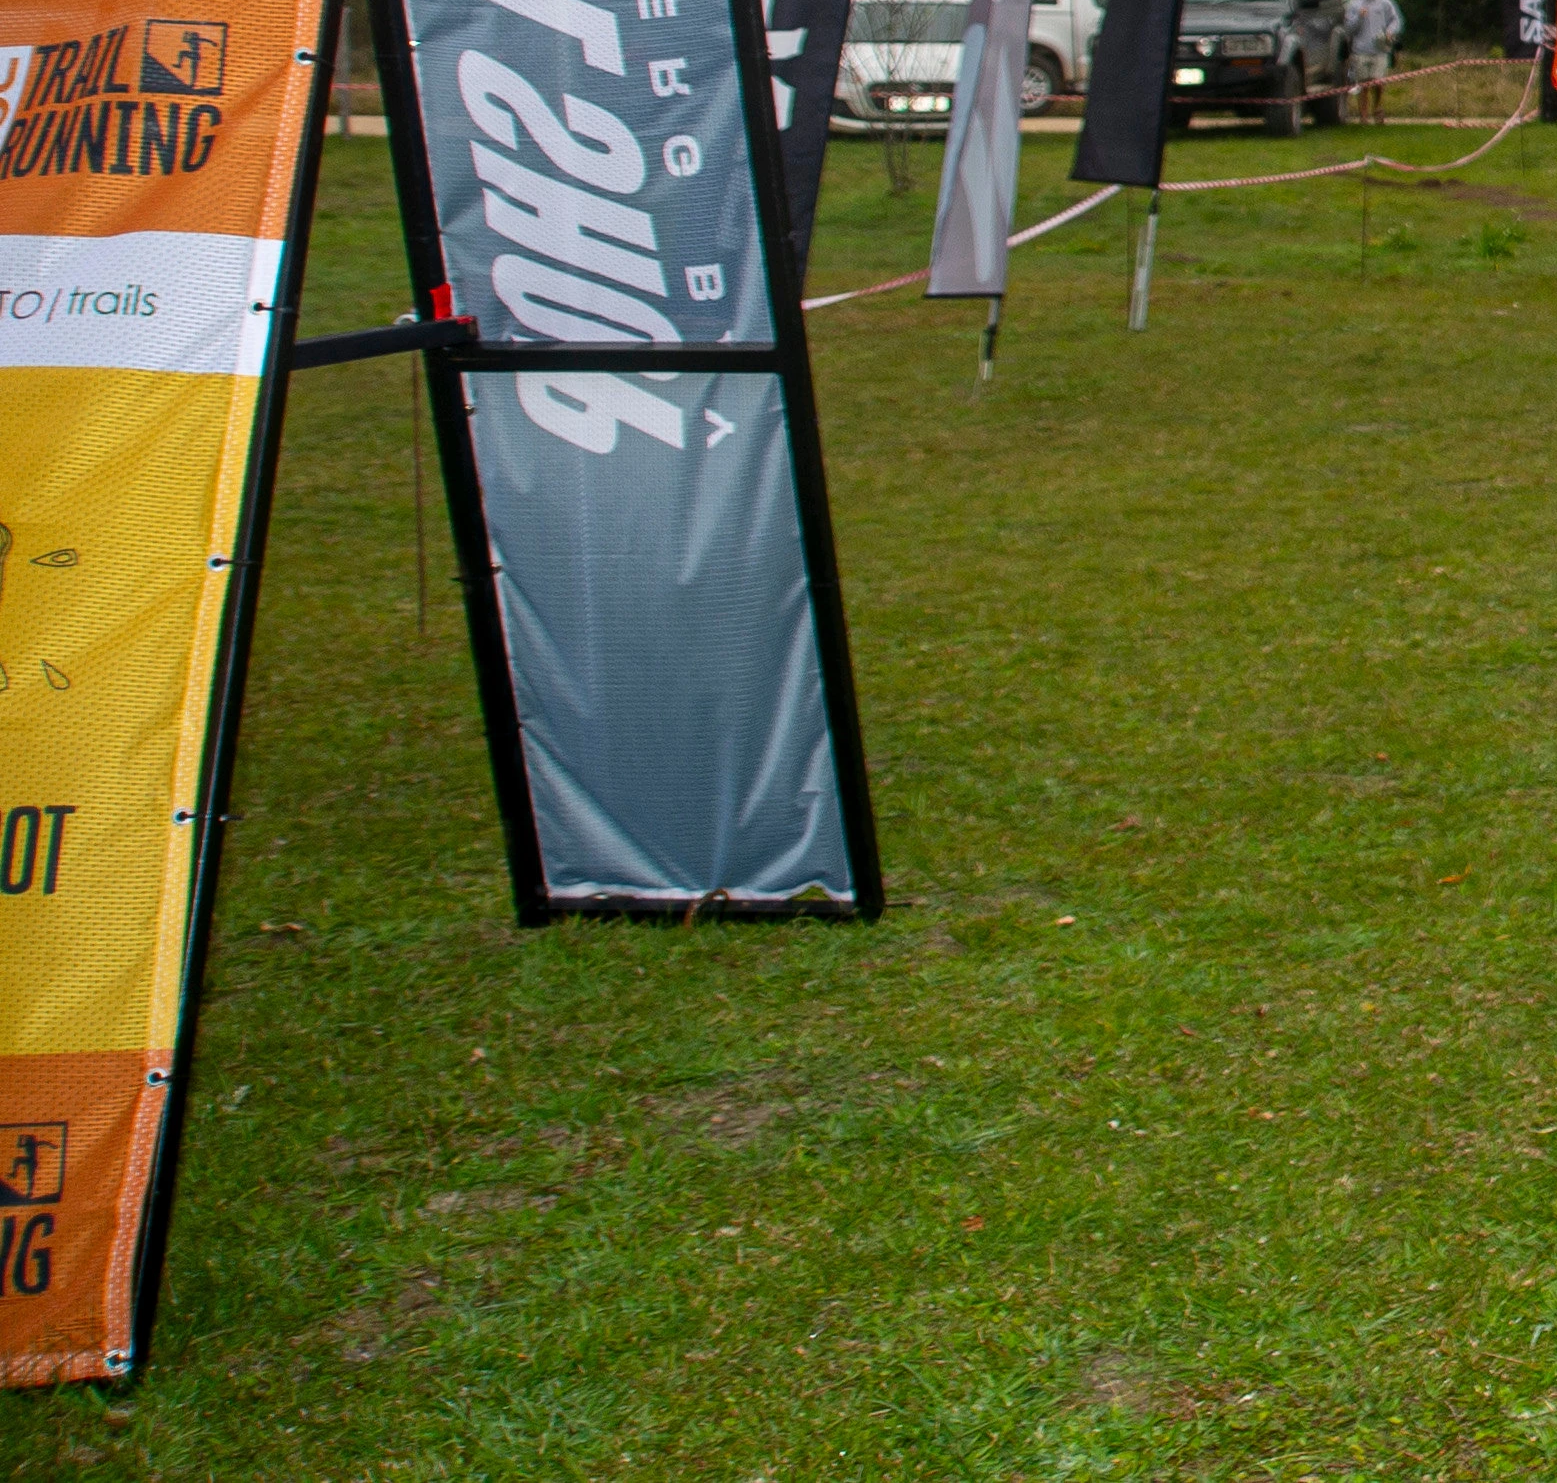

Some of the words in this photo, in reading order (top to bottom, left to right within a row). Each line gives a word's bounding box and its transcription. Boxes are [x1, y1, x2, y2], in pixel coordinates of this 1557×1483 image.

[23, 24, 130, 112] TRAIL
[0, 100, 223, 180] RUNNING
[67, 283, 159, 317] trails
